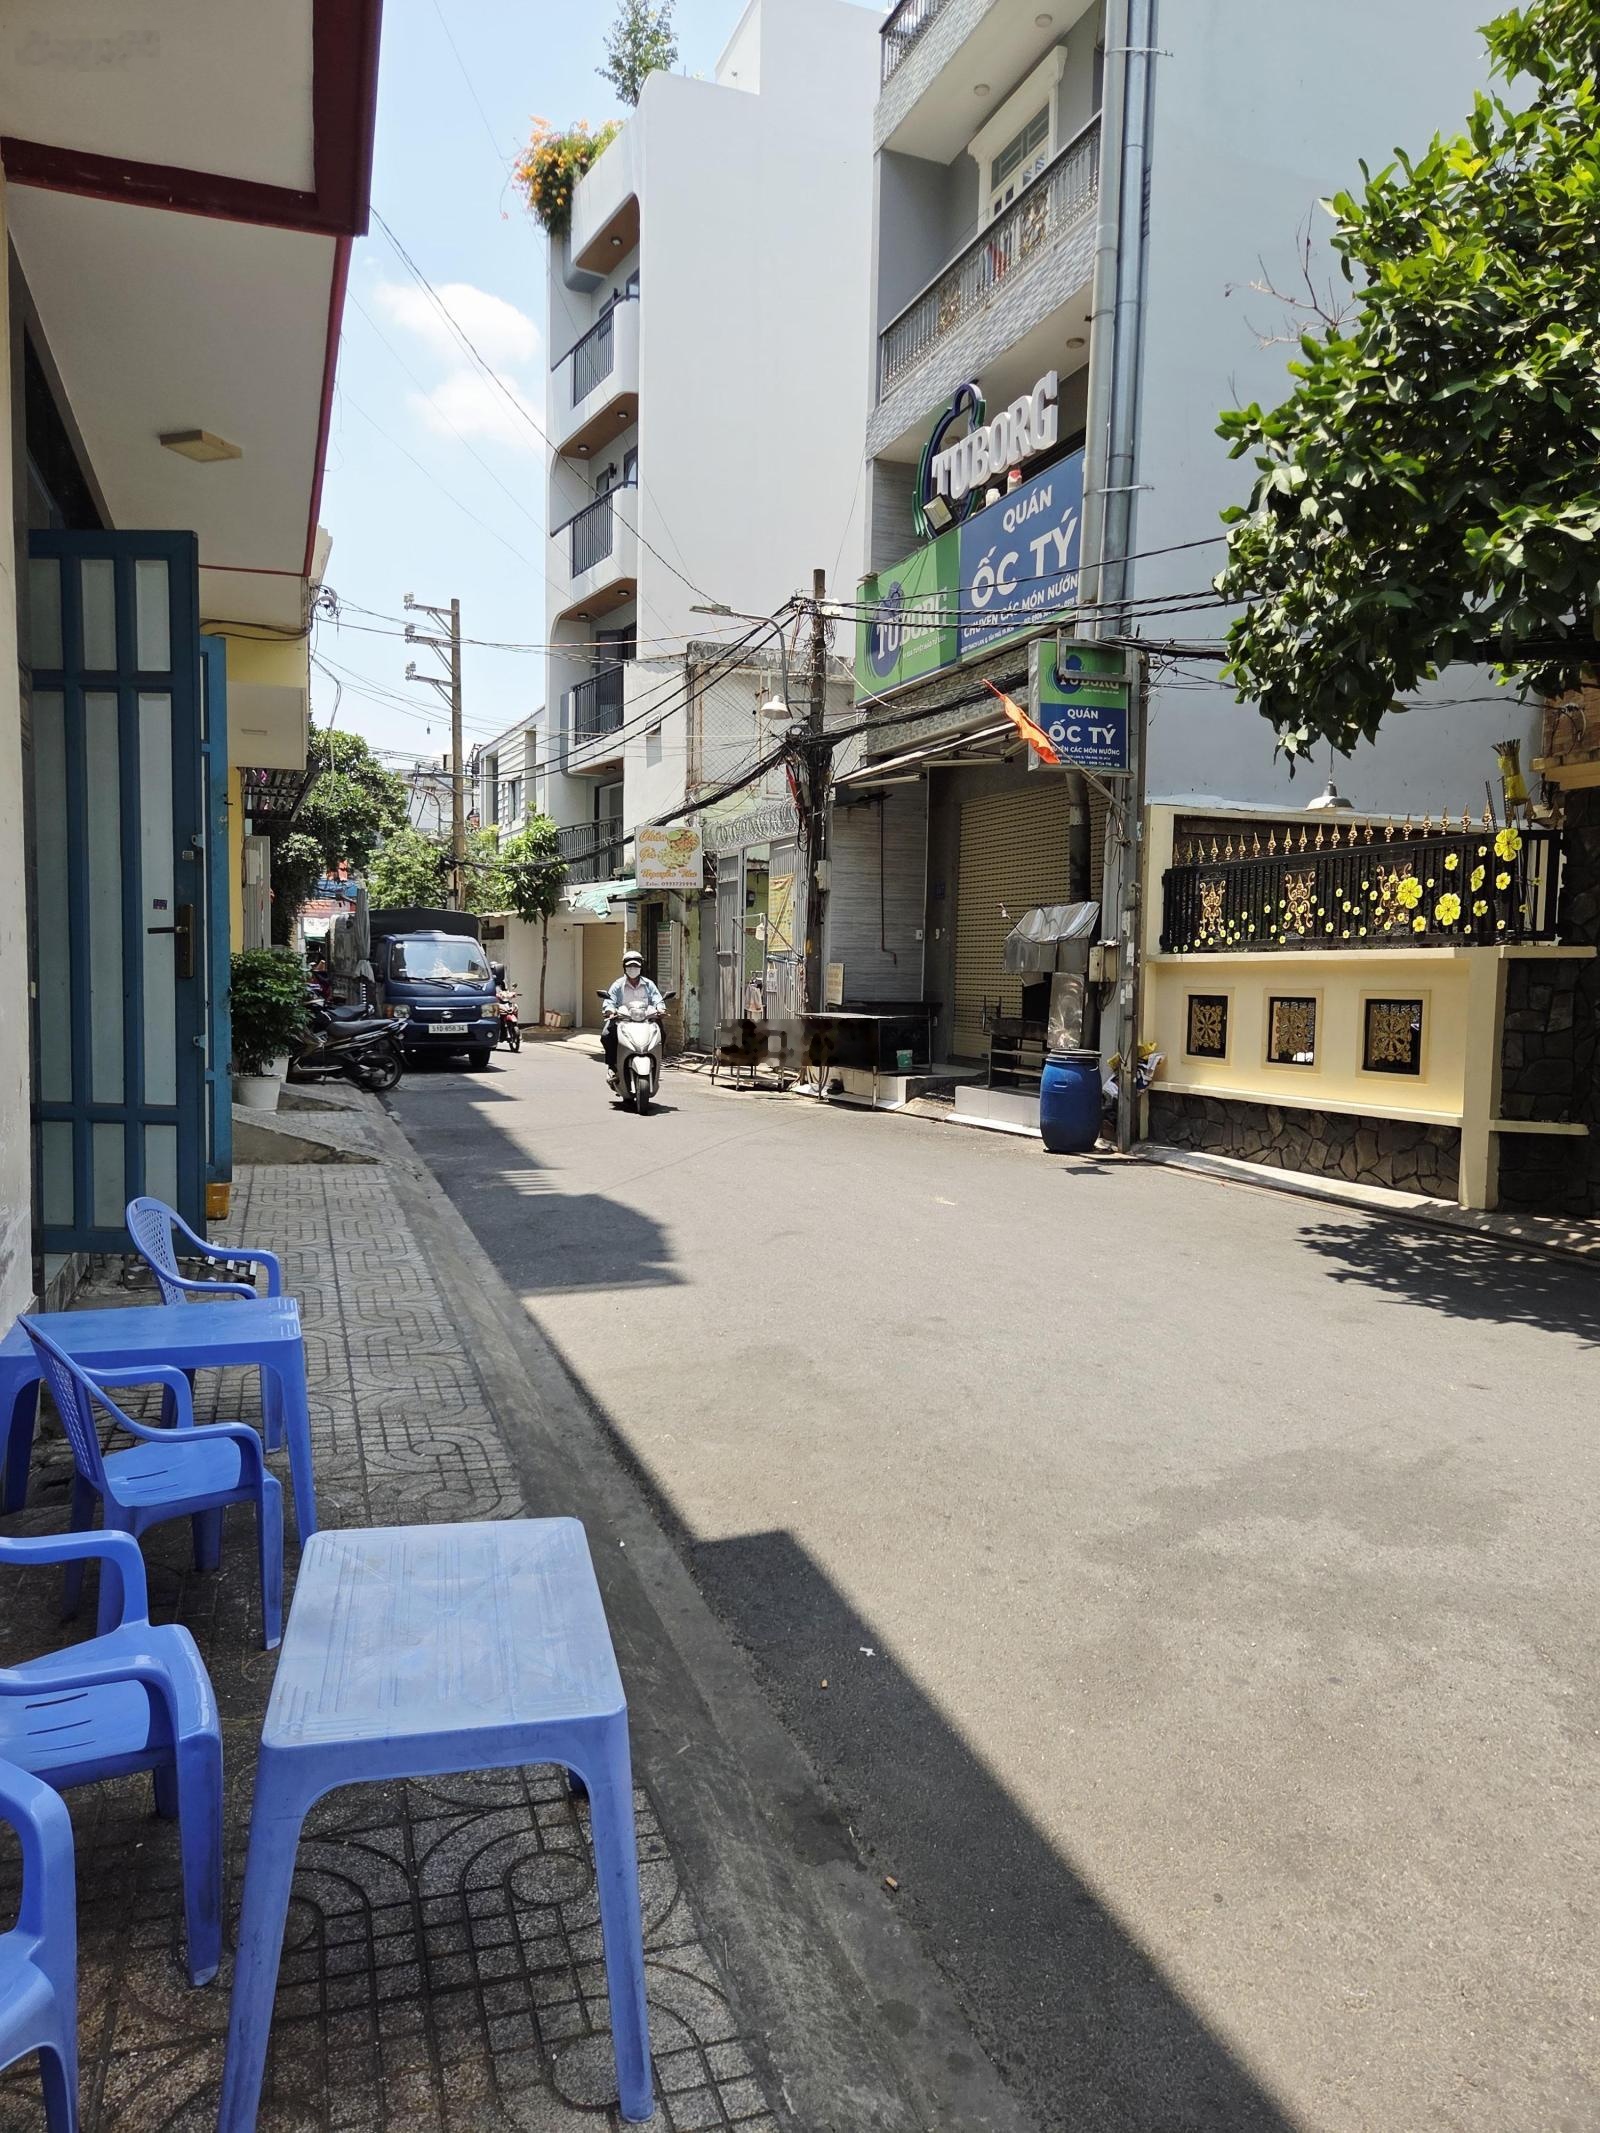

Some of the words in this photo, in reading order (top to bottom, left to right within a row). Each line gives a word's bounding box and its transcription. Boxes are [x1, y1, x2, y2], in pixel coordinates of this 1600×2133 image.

[932, 370, 1058, 499] TUBORG
[1002, 485, 1052, 533] QUÁN
[971, 545, 1019, 608] ỐC
[1029, 506, 1078, 577] TÝ
[1022, 588, 1045, 613] MÓN
[1048, 719, 1081, 743] ỐC
[1088, 723, 1117, 745] TÝ
[1067, 707, 1098, 720] QUÁN
